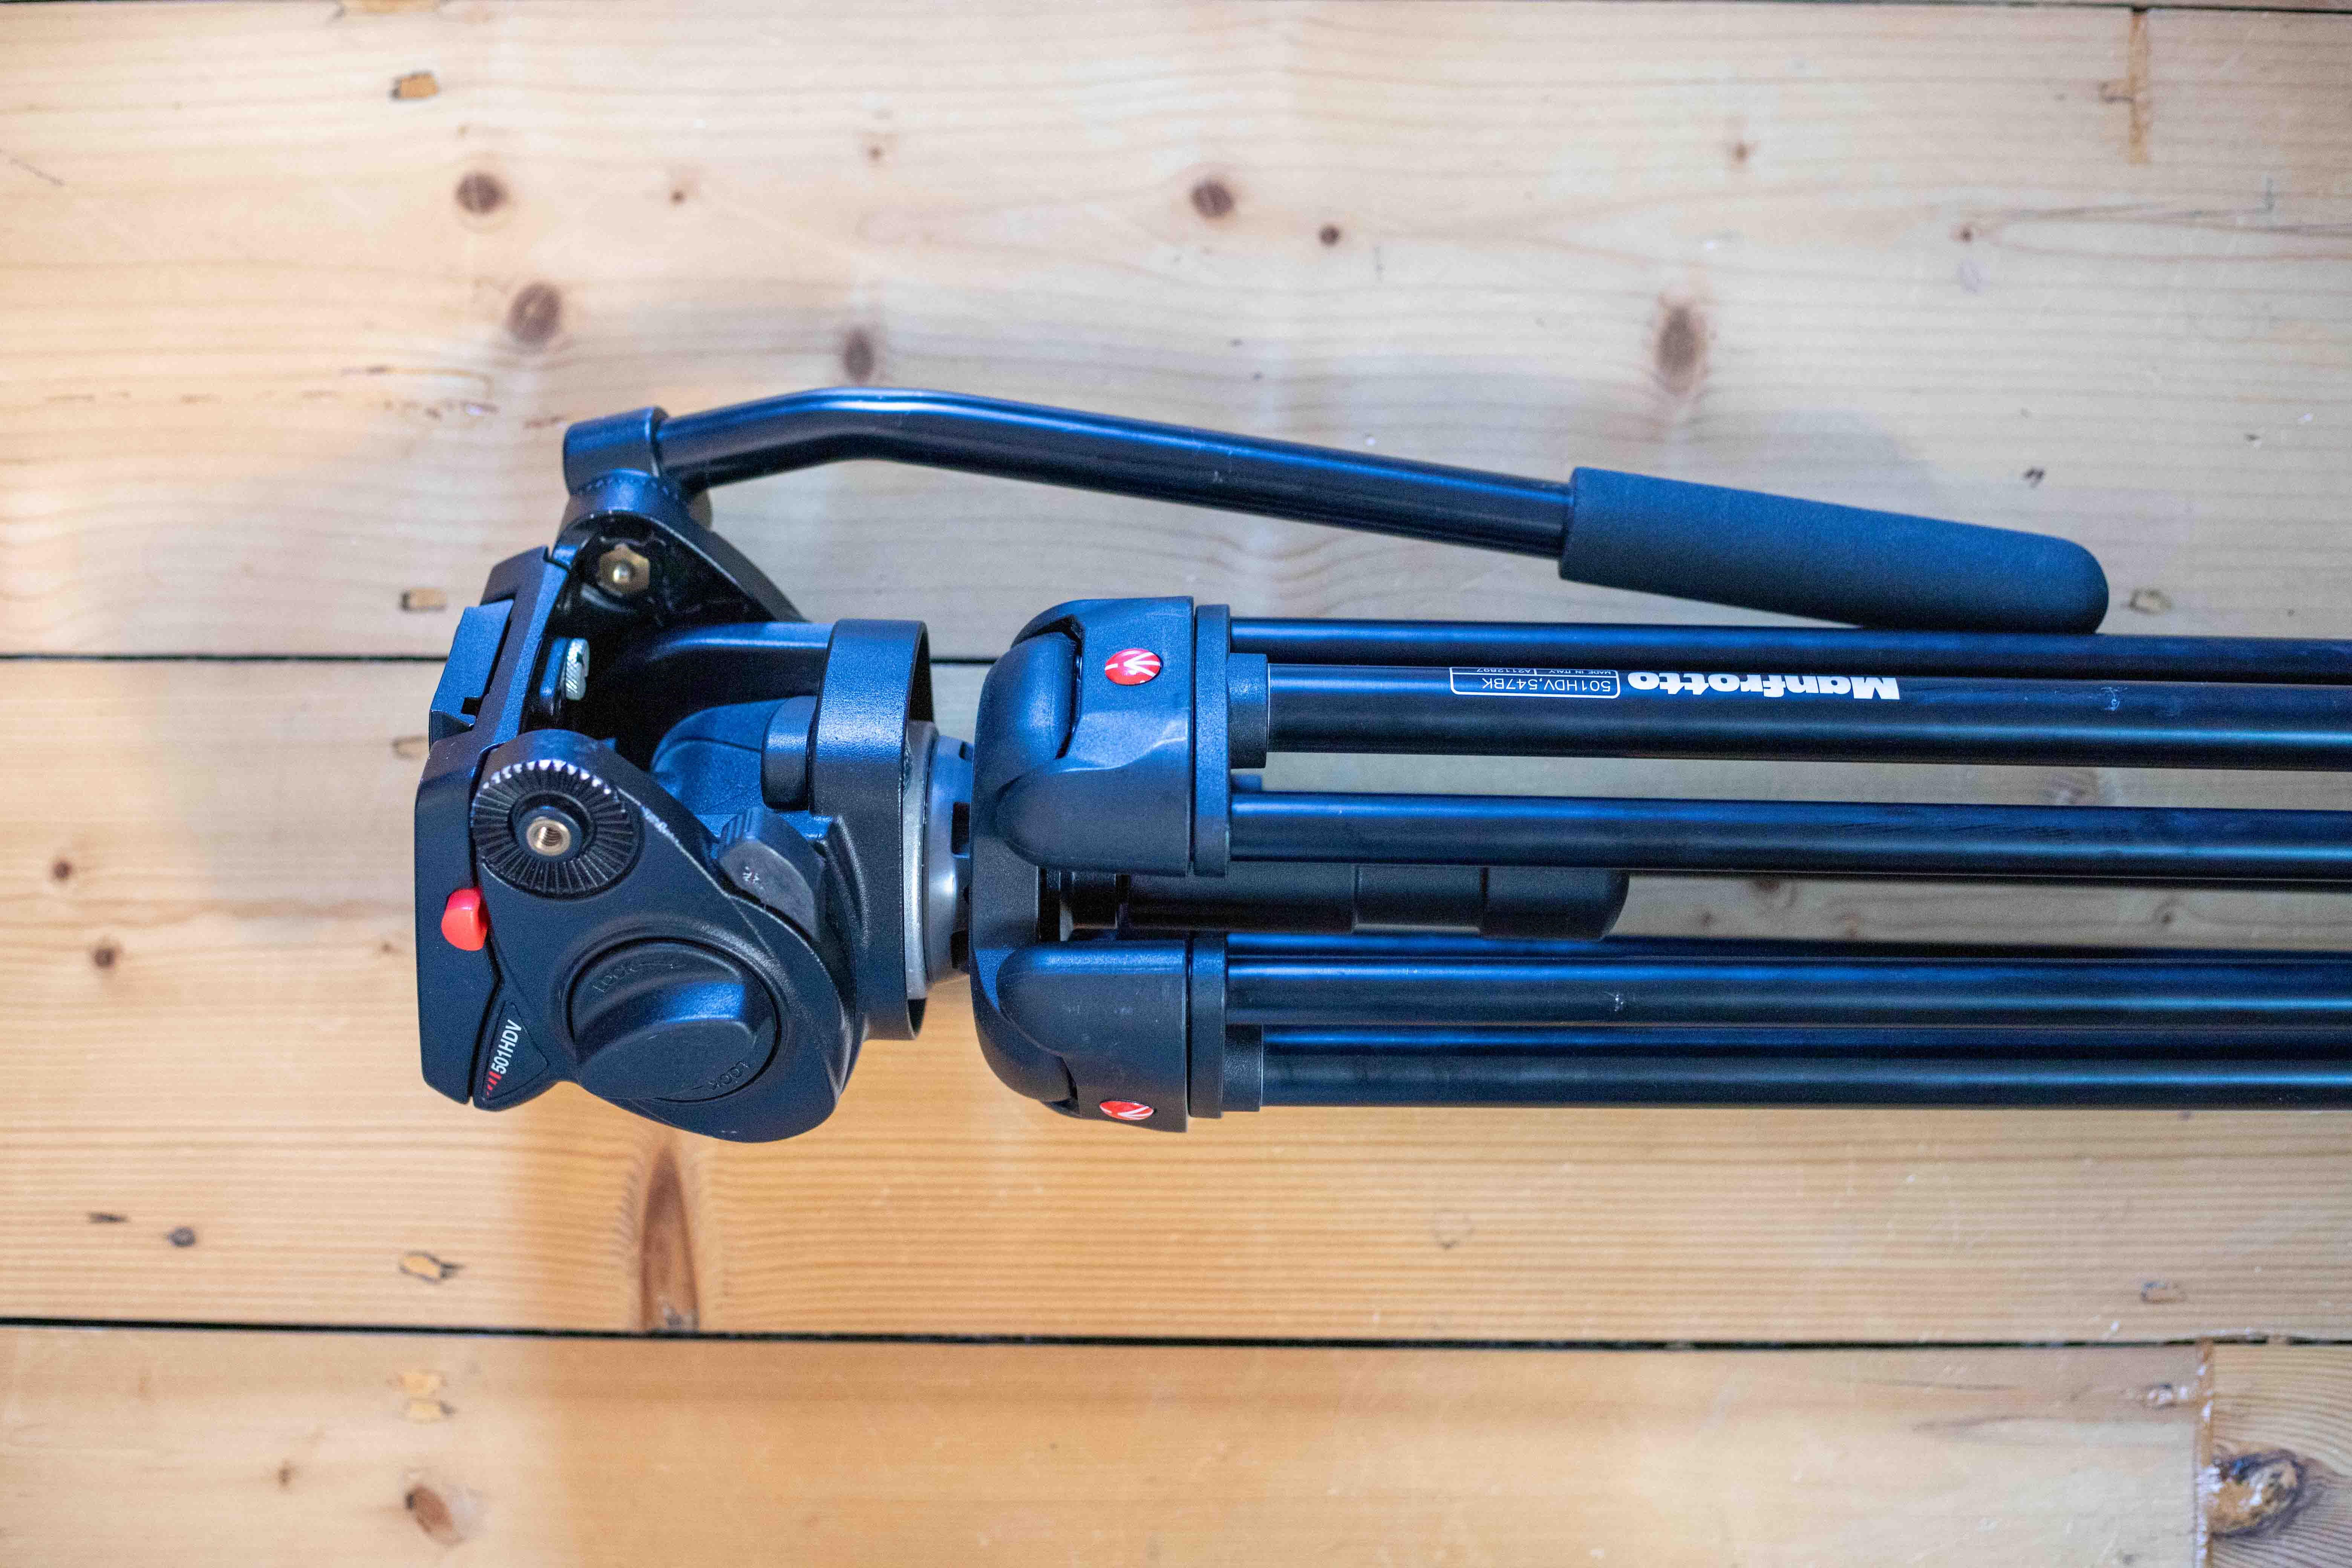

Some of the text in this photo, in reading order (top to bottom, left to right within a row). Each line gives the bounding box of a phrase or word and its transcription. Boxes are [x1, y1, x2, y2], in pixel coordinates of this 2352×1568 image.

[1482, 677, 1611, 692] 501HDV,547BK
[1628, 672, 1900, 700] Manfrotto
[490, 1019, 522, 1074] 501HDV
[709, 1061, 749, 1089] LOCK
